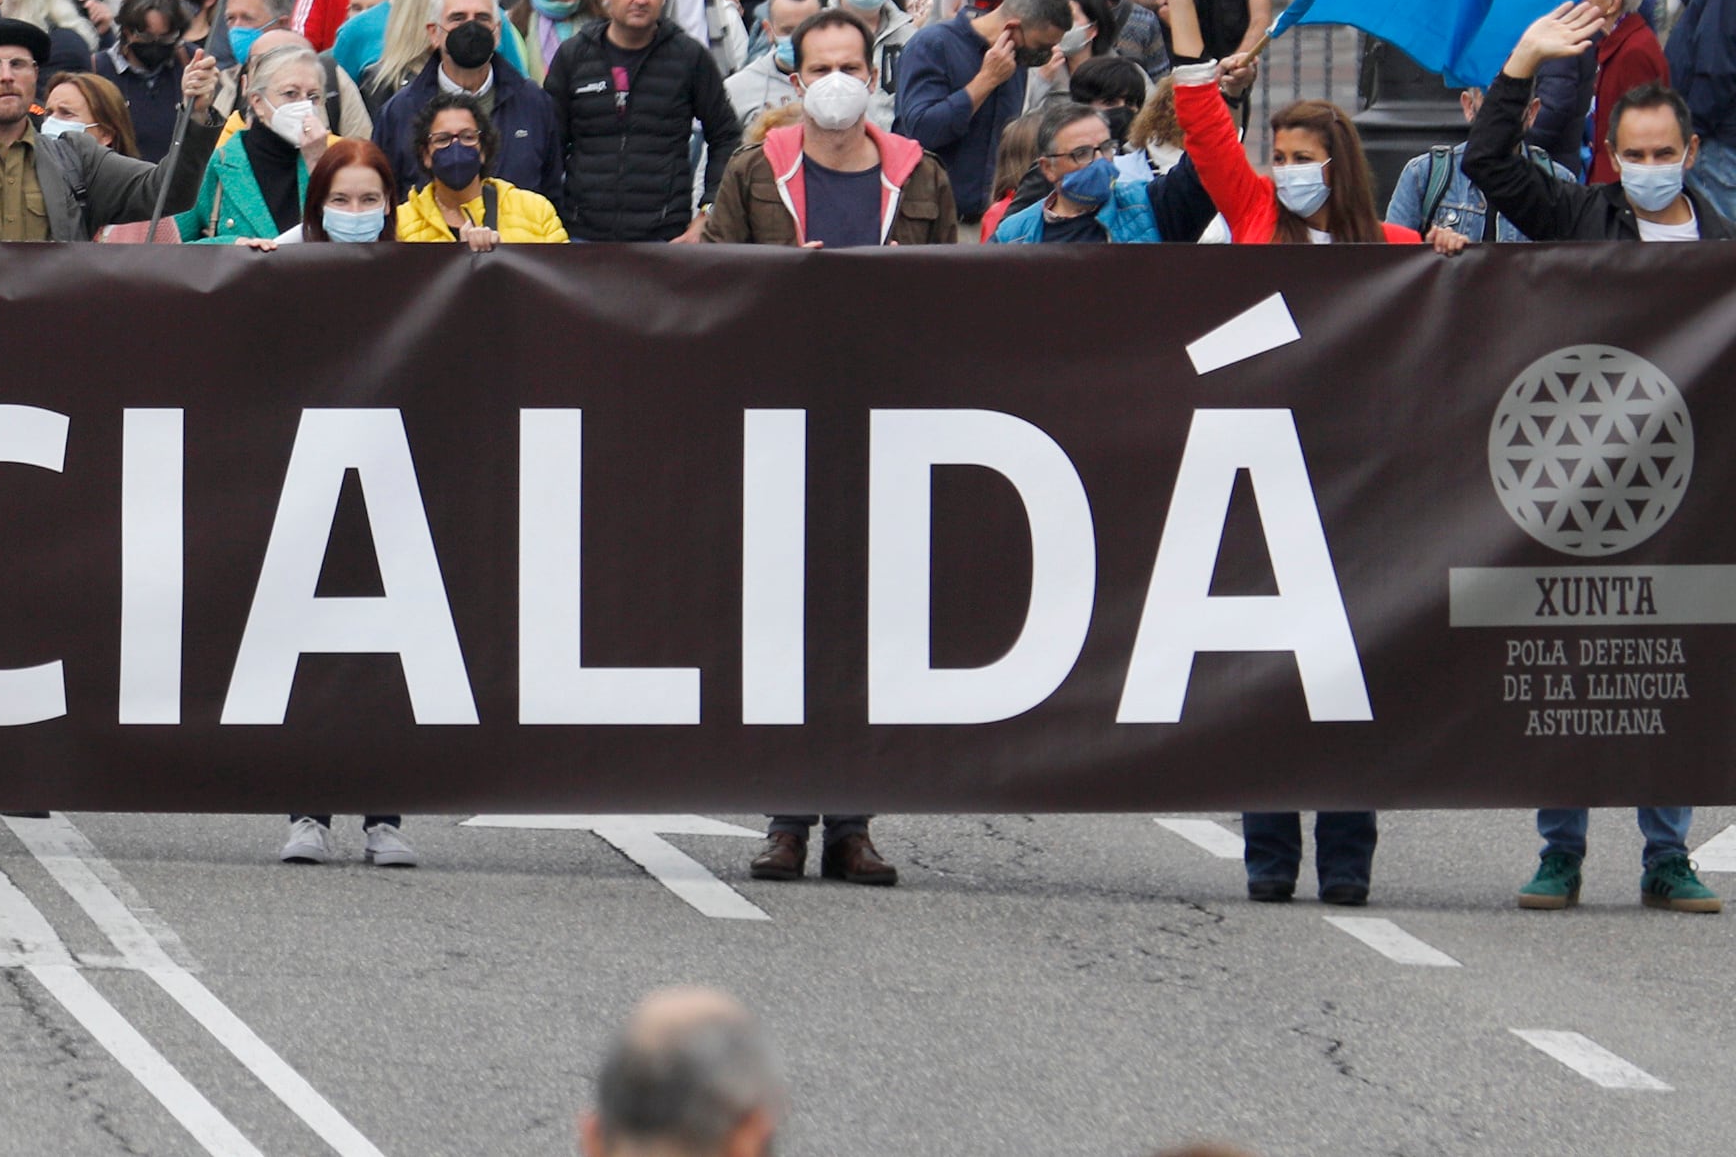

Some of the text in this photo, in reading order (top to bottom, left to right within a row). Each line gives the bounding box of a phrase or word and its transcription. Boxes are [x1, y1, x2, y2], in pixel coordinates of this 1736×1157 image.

[1534, 576, 1658, 617] XUNTA
[1506, 638, 1686, 666] POLA DEFENSA
[1503, 673, 1690, 701] DE LA LLINGUA
[1524, 708, 1666, 735] ASTURIANA
